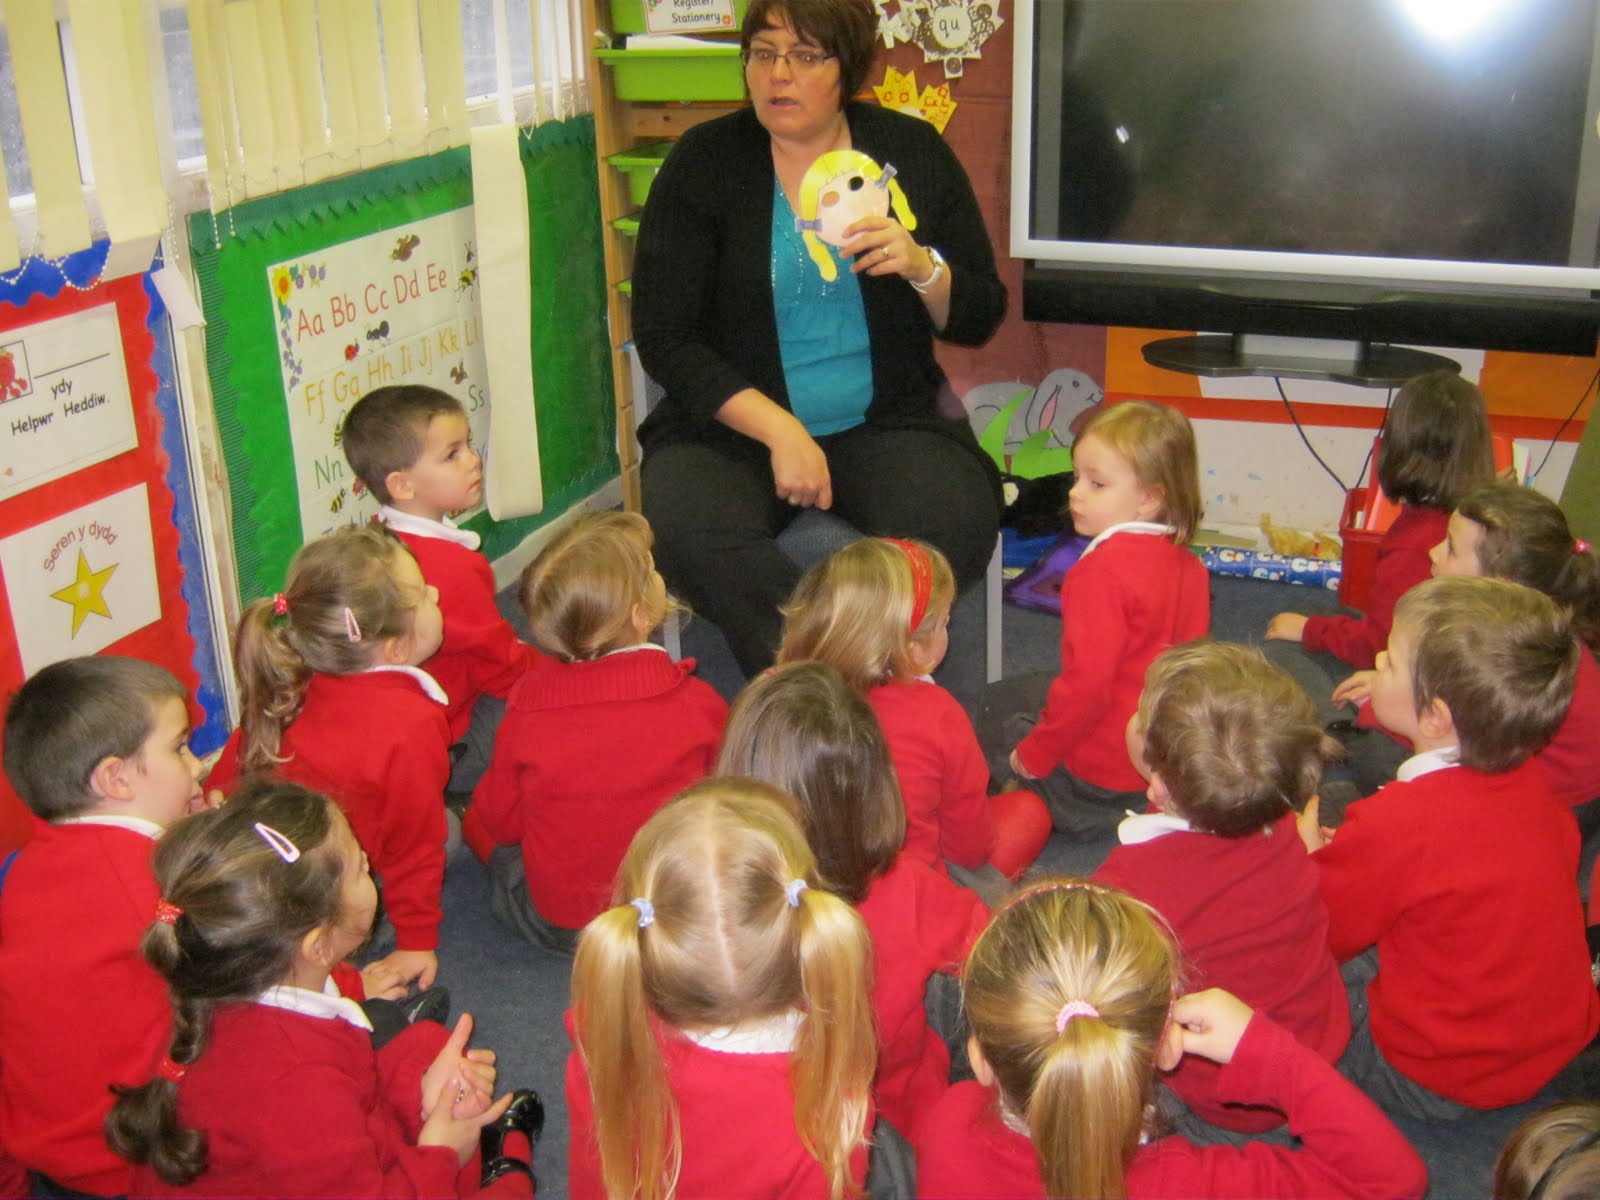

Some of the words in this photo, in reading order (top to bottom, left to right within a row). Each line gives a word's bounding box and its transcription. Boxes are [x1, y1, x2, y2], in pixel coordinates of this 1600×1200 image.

[671, 13, 720, 24] Stationery
[939, 18, 960, 39] qu
[297, 308, 325, 342] Aa
[330, 295, 357, 328] Bb
[364, 284, 390, 314] Cc
[393, 270, 421, 304] Dd
[427, 263, 448, 293] Ee
[51, 378, 73, 400] ydy
[304, 379, 325, 425] Ff
[367, 354, 395, 389] Hh
[400, 345, 413, 376] Ii
[418, 335, 433, 376] Jj
[438, 327, 460, 359] Kk
[11, 411, 54, 436] Helpwr
[63, 394, 110, 418] Heddiw.
[314, 455, 344, 489] Nn
[43, 530, 76, 572] Seren
[77, 525, 86, 543] y
[88, 520, 118, 546] dydd
